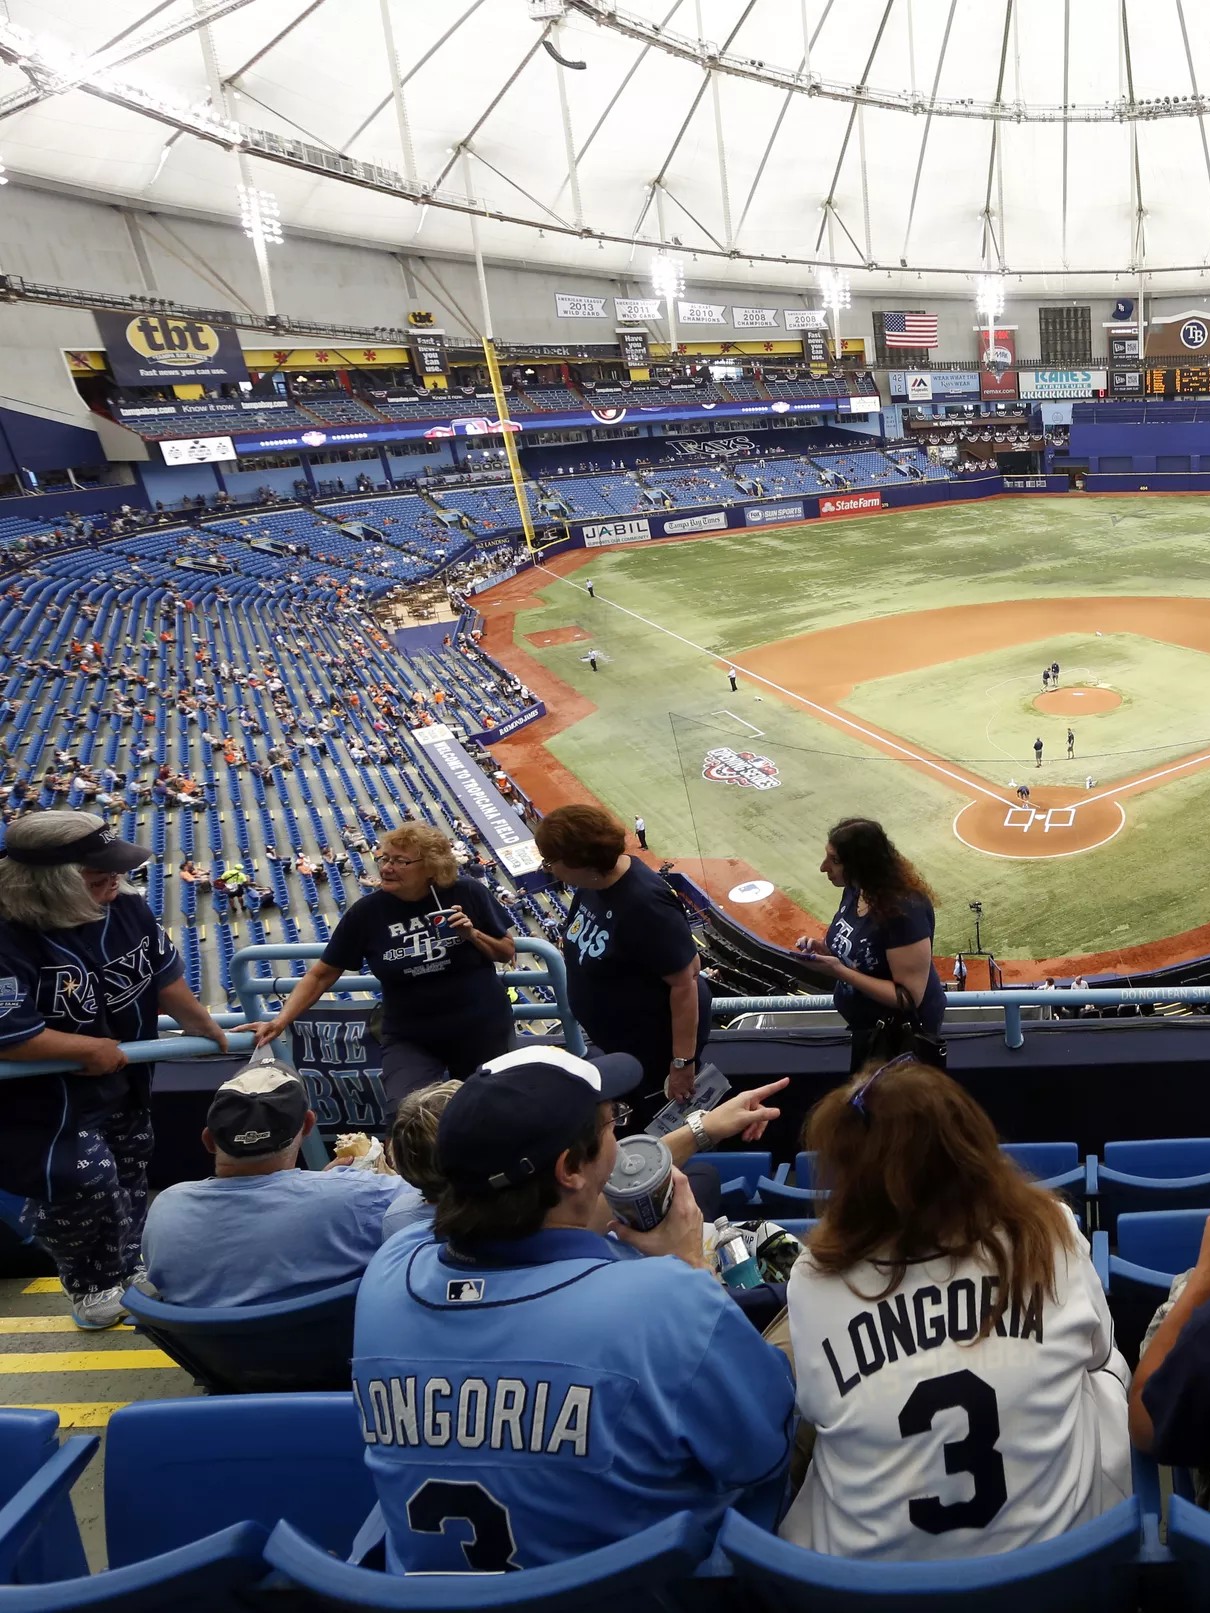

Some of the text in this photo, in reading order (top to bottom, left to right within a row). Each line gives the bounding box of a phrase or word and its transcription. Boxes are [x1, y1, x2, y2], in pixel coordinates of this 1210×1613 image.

[570, 302, 594, 312] 2013
[627, 306, 650, 314] 2011
[689, 309, 714, 318] 2010
[137, 317, 209, 352] tbt
[1185, 325, 1204, 344] TB
[139, 368, 158, 377] Fast
[180, 370, 196, 378] you
[212, 368, 228, 376] use.
[892, 374, 902, 382] 42
[894, 384, 902, 392] 12
[182, 404, 206, 413] Know
[208, 404, 216, 412] it
[666, 436, 756, 456] RAYS
[765, 510, 778, 518] SUN
[778, 507, 802, 516] SPORTS
[668, 516, 721, 531] Tampa Bay Times
[586, 522, 648, 539] JABIL
[484, 538, 510, 548] LANDING
[621, 534, 650, 542] COMMUNITY
[499, 709, 539, 736] RAYMOND JAMES
[434, 741, 520, 844] WELCOME TO TROPICANA FIELD
[403, 930, 448, 964] TB
[390, 948, 406, 960] 19
[1121, 989, 1138, 1000] DO
[1138, 989, 1161, 1000] NOT
[1192, 988, 1208, 999] SIT
[740, 998, 756, 1009] SIT
[778, 998, 793, 1008] OR
[794, 997, 827, 1008] STAND
[294, 1021, 367, 1064] THE
[822, 1275, 1044, 1398] LONGORIA
[354, 1376, 592, 1458] LONGORIA
[898, 1368, 1008, 1535] 3
